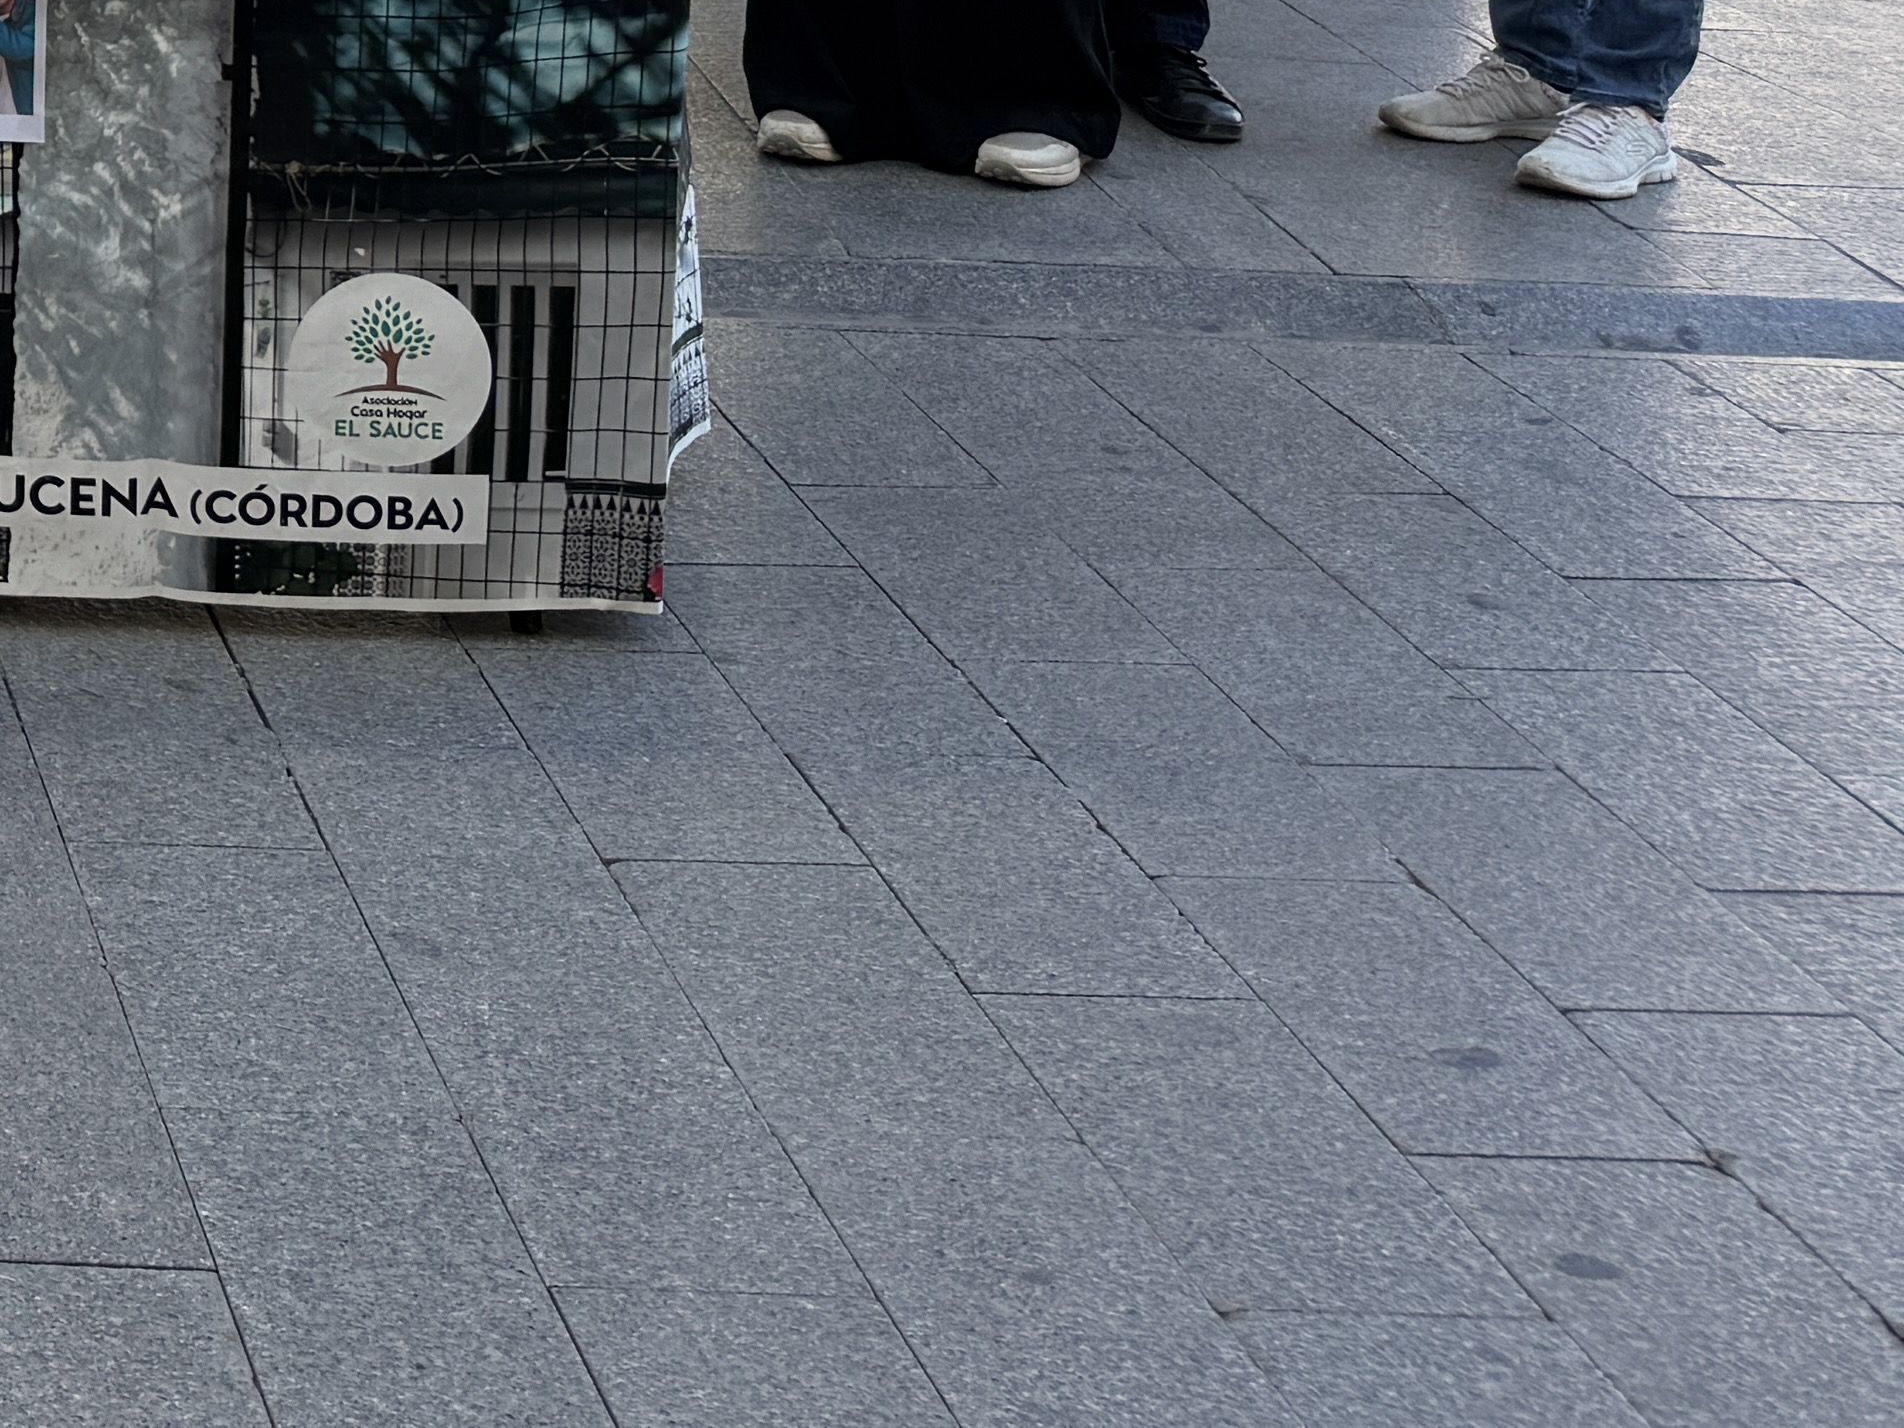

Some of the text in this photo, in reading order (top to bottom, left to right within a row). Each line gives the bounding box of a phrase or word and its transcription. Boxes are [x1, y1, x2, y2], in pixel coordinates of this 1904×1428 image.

[350, 405, 428, 421] Casa Hogar
[335, 419, 444, 440] EL SAUCE
[190, 483, 465, 533] (CÓRDOBA)
